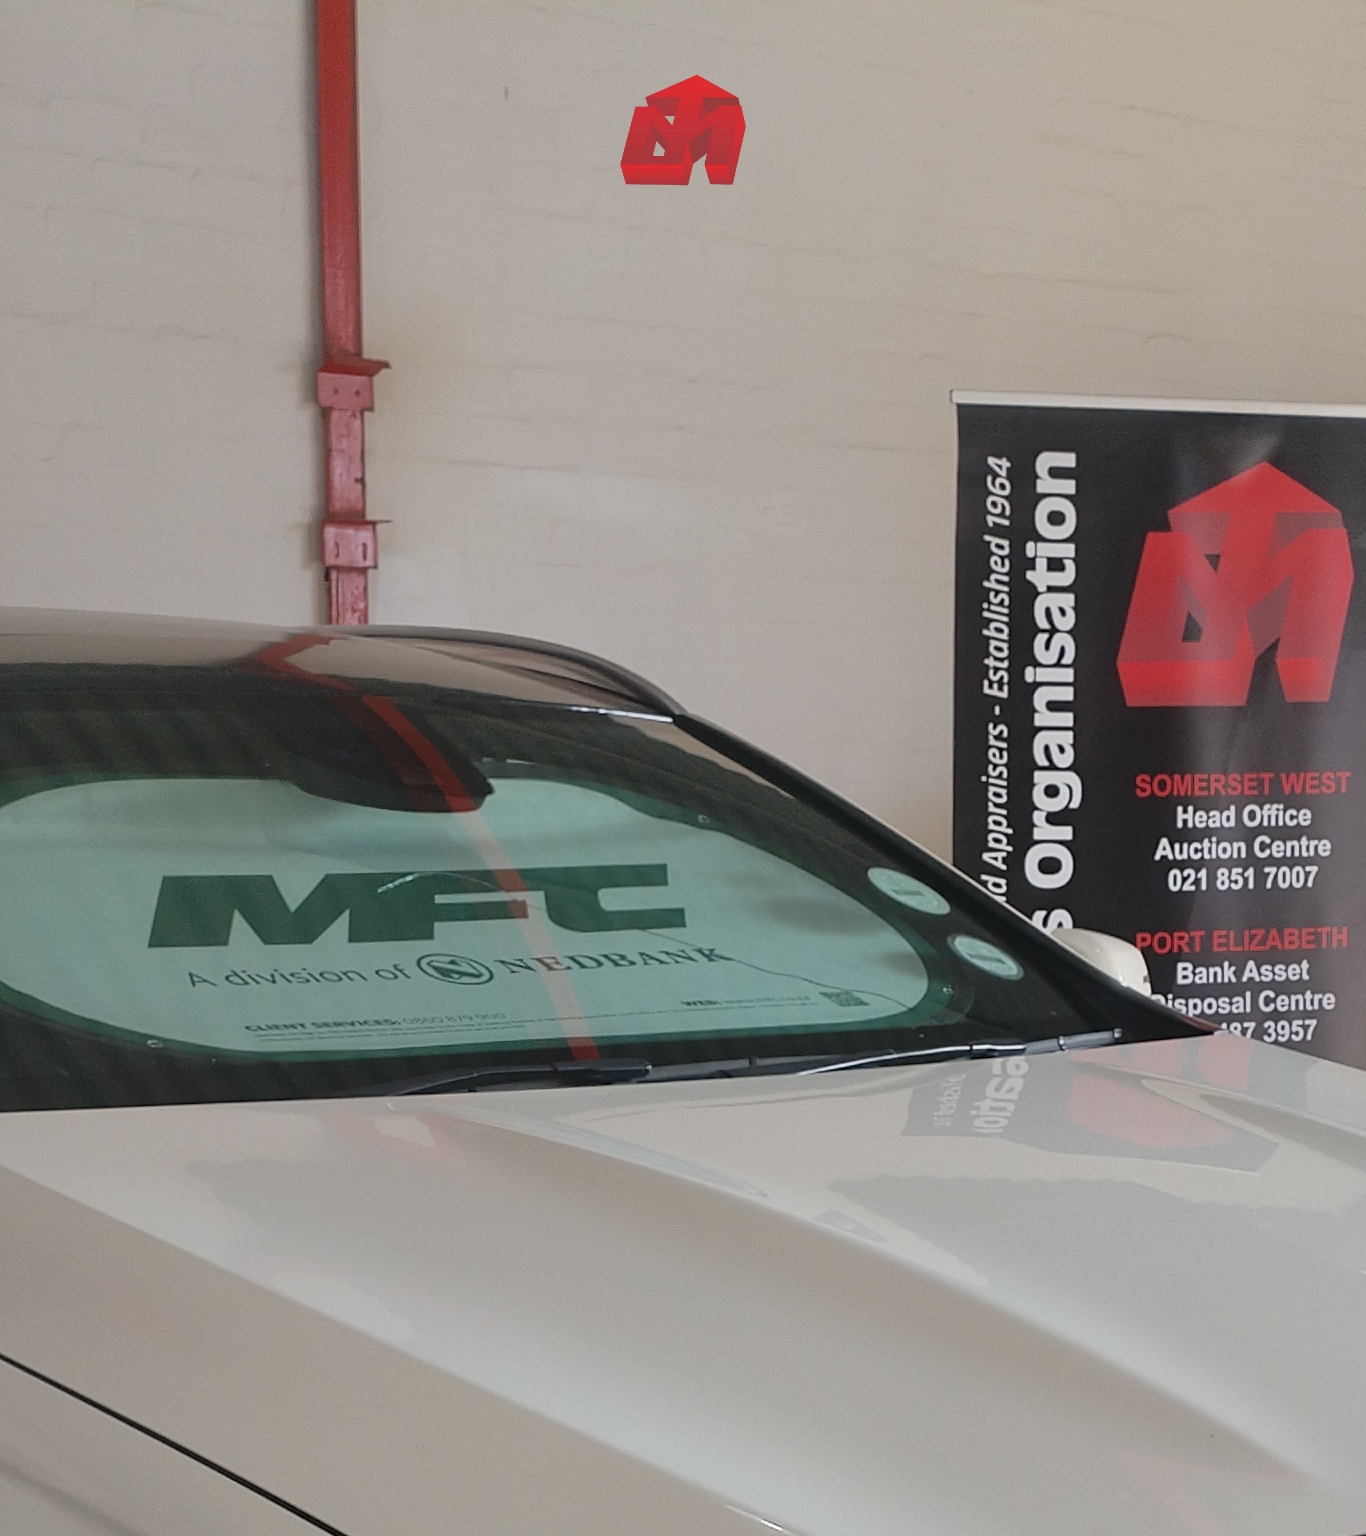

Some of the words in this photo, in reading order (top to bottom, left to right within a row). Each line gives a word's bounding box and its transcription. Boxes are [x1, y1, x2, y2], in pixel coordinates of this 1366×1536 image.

[985, 454, 1013, 528] 1964
[981, 533, 1011, 699] Established
[1023, 449, 1082, 890] Organisation
[980, 722, 1014, 871] Appraisers
[1135, 772, 1276, 798] SOMERSET
[1280, 770, 1353, 796] WEST
[1175, 804, 1237, 830] Head
[1241, 802, 1313, 828] Office
[1153, 836, 1247, 862] Auction
[1252, 834, 1333, 860] Centre
[1166, 867, 1209, 893] 021
[1215, 866, 1256, 892] 851
[1262, 865, 1320, 890] 7007
[147, 862, 688, 949] MFC
[1135, 929, 1206, 956] PORT
[1211, 925, 1349, 953] ELIZABETH
[188, 971, 217, 989] A
[225, 963, 367, 988] division
[374, 963, 410, 983] of
[494, 946, 735, 974] NEDBANK
[1175, 959, 1238, 986] Bank
[1241, 957, 1311, 983] Asset
[1257, 989, 1337, 1014] Centre
[1262, 1018, 1319, 1044] 3957
